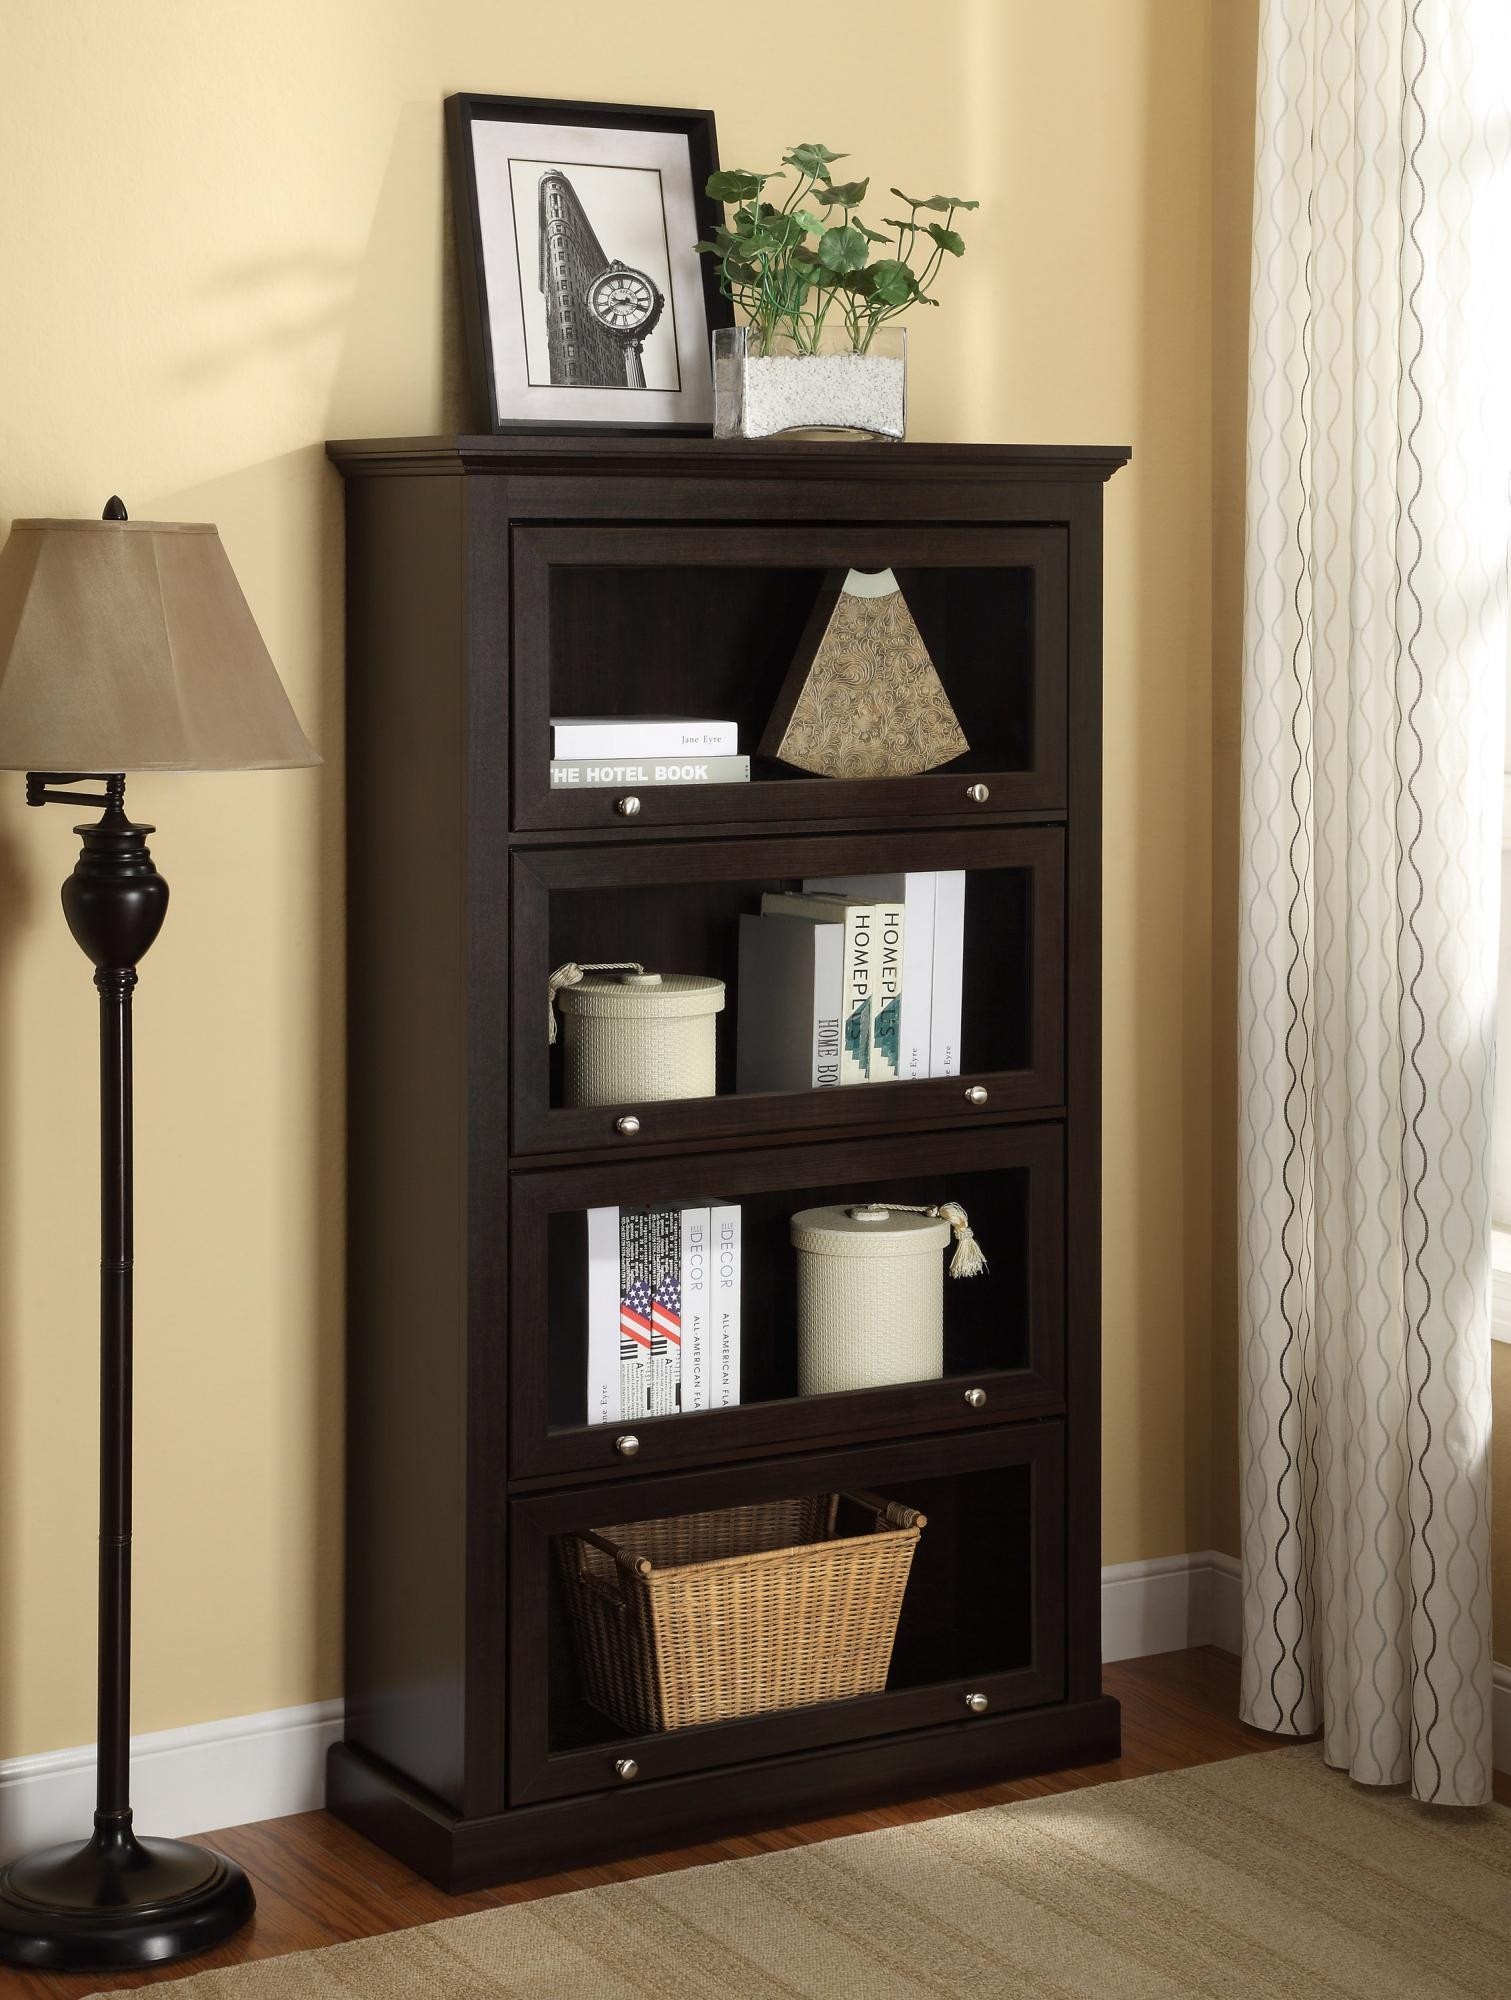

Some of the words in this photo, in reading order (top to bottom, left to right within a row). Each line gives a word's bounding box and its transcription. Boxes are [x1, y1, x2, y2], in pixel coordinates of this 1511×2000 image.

[681, 735, 699, 744] Jane
[703, 735, 722, 744] Eyre
[551, 767, 580, 783] HE
[586, 766, 649, 782] HOTEL
[655, 765, 709, 781] BOOK
[818, 1018, 839, 1058] HOME
[690, 1232, 704, 1291] DECOR
[720, 1229, 734, 1289] DECOR
[693, 1315, 701, 1388] ALL-AMERICAN
[722, 1312, 730, 1386] ALL-AMERICAN
